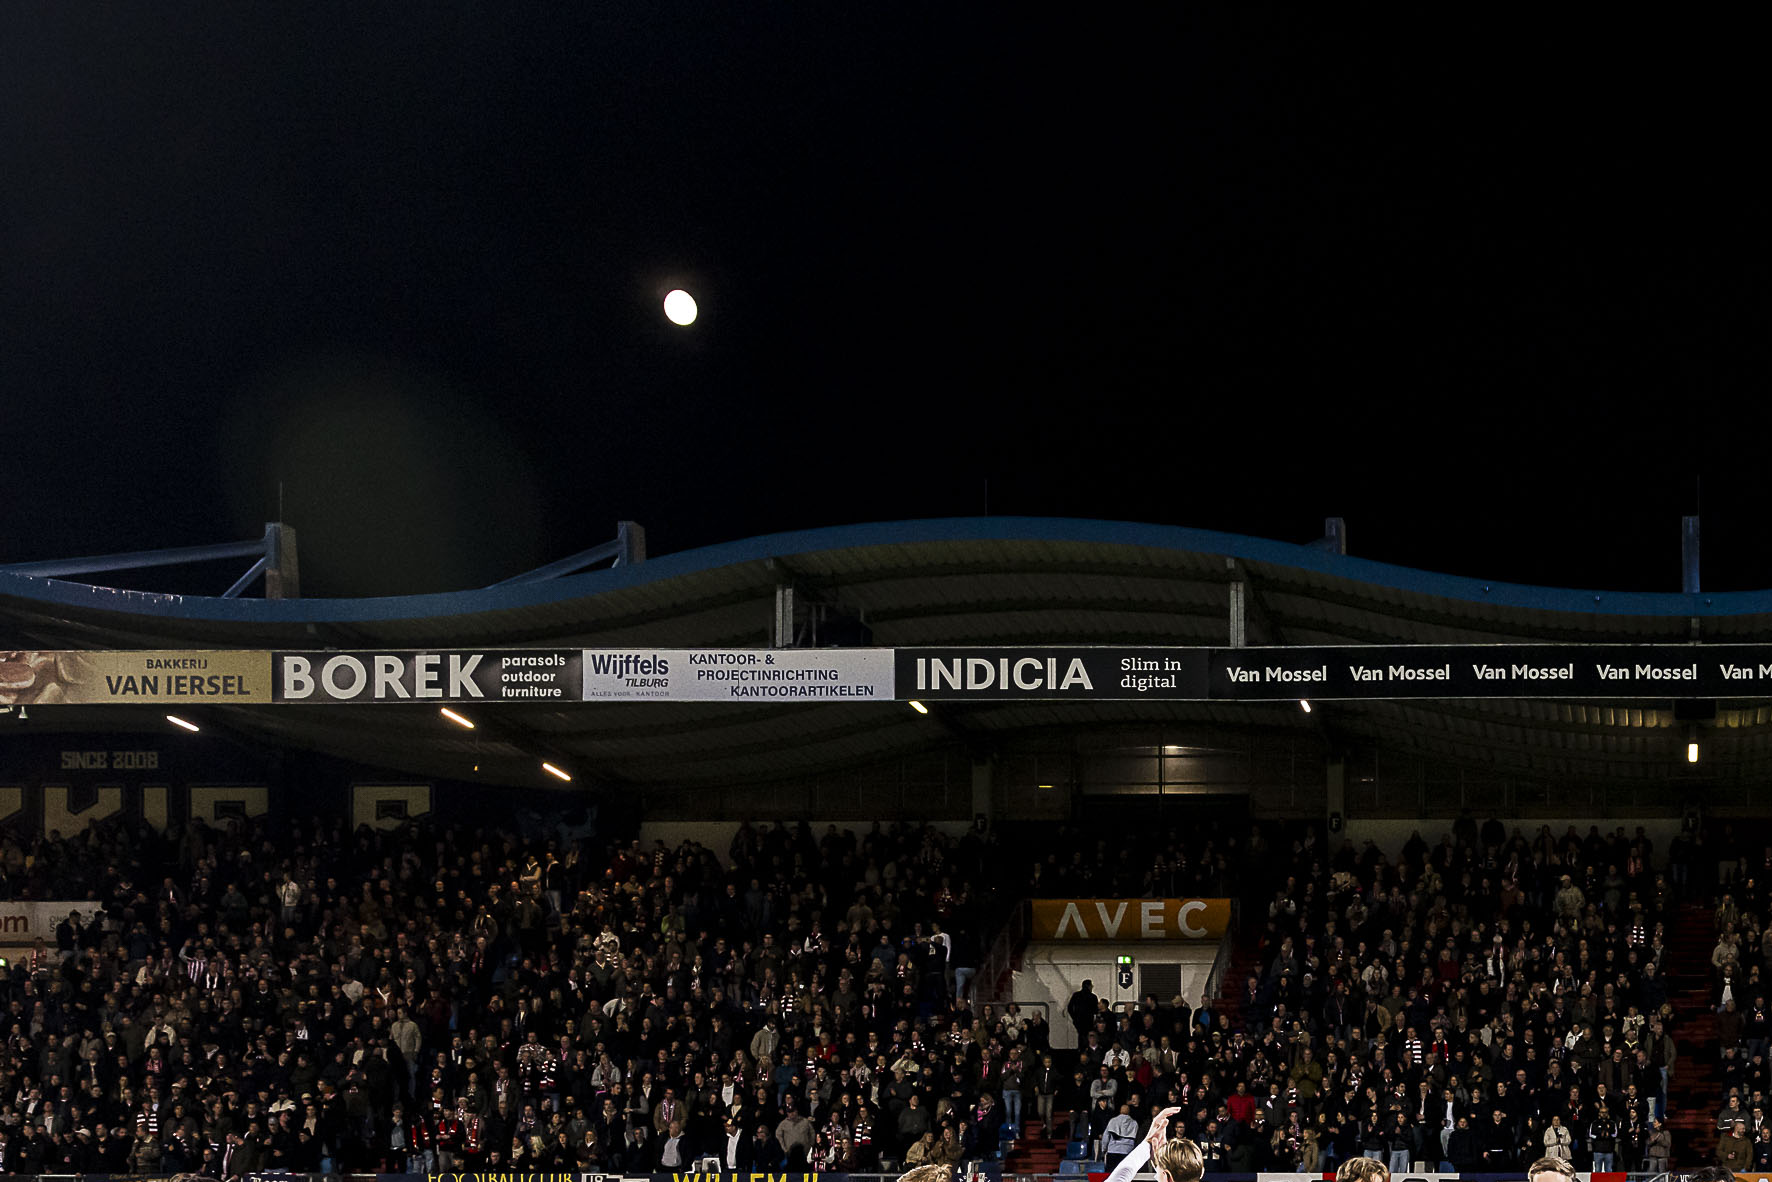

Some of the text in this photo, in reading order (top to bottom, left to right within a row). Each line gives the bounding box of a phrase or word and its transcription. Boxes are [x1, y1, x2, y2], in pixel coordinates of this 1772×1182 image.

[146, 658, 208, 670] BAKKERIJ
[501, 656, 566, 668] parasols
[591, 655, 669, 679] Wijffels
[689, 655, 775, 665] KANTOOR- &
[1121, 658, 1182, 672] Slim in
[284, 655, 484, 700] BOREK
[501, 672, 556, 683] outdoor
[697, 670, 839, 681] PROJECTINRICHTING
[916, 657, 1093, 690] INDICIA
[1227, 666, 1327, 682] Van Mossel
[1350, 665, 1450, 681] Van Mossel
[1473, 664, 1573, 680] Van Mossel
[1597, 664, 1697, 680] Van Mossel
[1720, 664, 1753, 679] Van
[106, 675, 250, 695] VAN IERSEL
[625, 678, 669, 688] TILBURG
[1121, 675, 1176, 692] digital
[501, 686, 562, 698] furniture
[731, 685, 874, 697] KANTOORARTIKELEN
[61, 752, 110, 769] SINCE
[1054, 901, 1208, 939] AVEC
[1121, 973, 1130, 983] F
